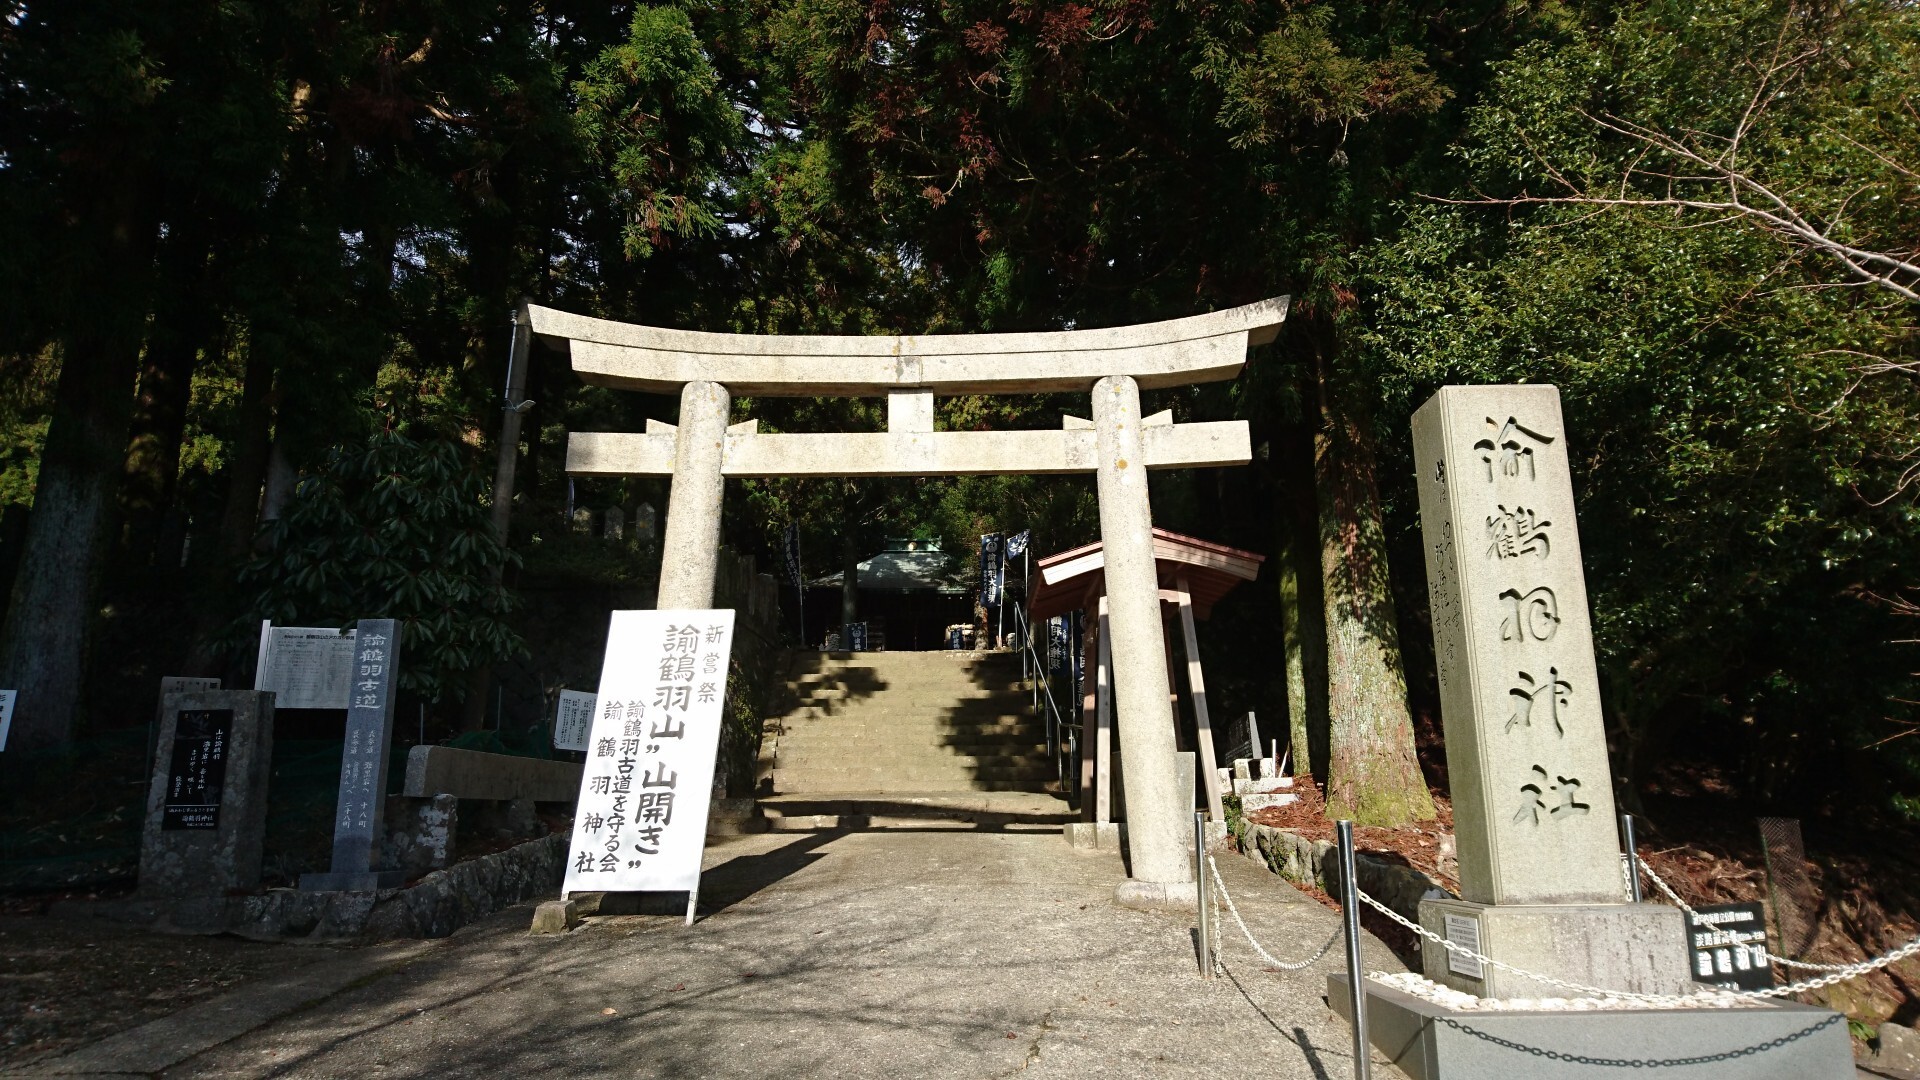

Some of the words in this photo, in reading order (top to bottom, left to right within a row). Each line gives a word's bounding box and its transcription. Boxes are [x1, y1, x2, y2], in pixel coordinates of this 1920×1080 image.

[355, 634, 387, 709] 諭鶴羽古道
[697, 624, 725, 704] 新嘗祭
[342, 802, 353, 828] 二十八町
[358, 801, 368, 828] 十八町
[575, 701, 625, 873] 諭鶴羽神社
[599, 700, 646, 873] 諭鶴羽古道を守る会
